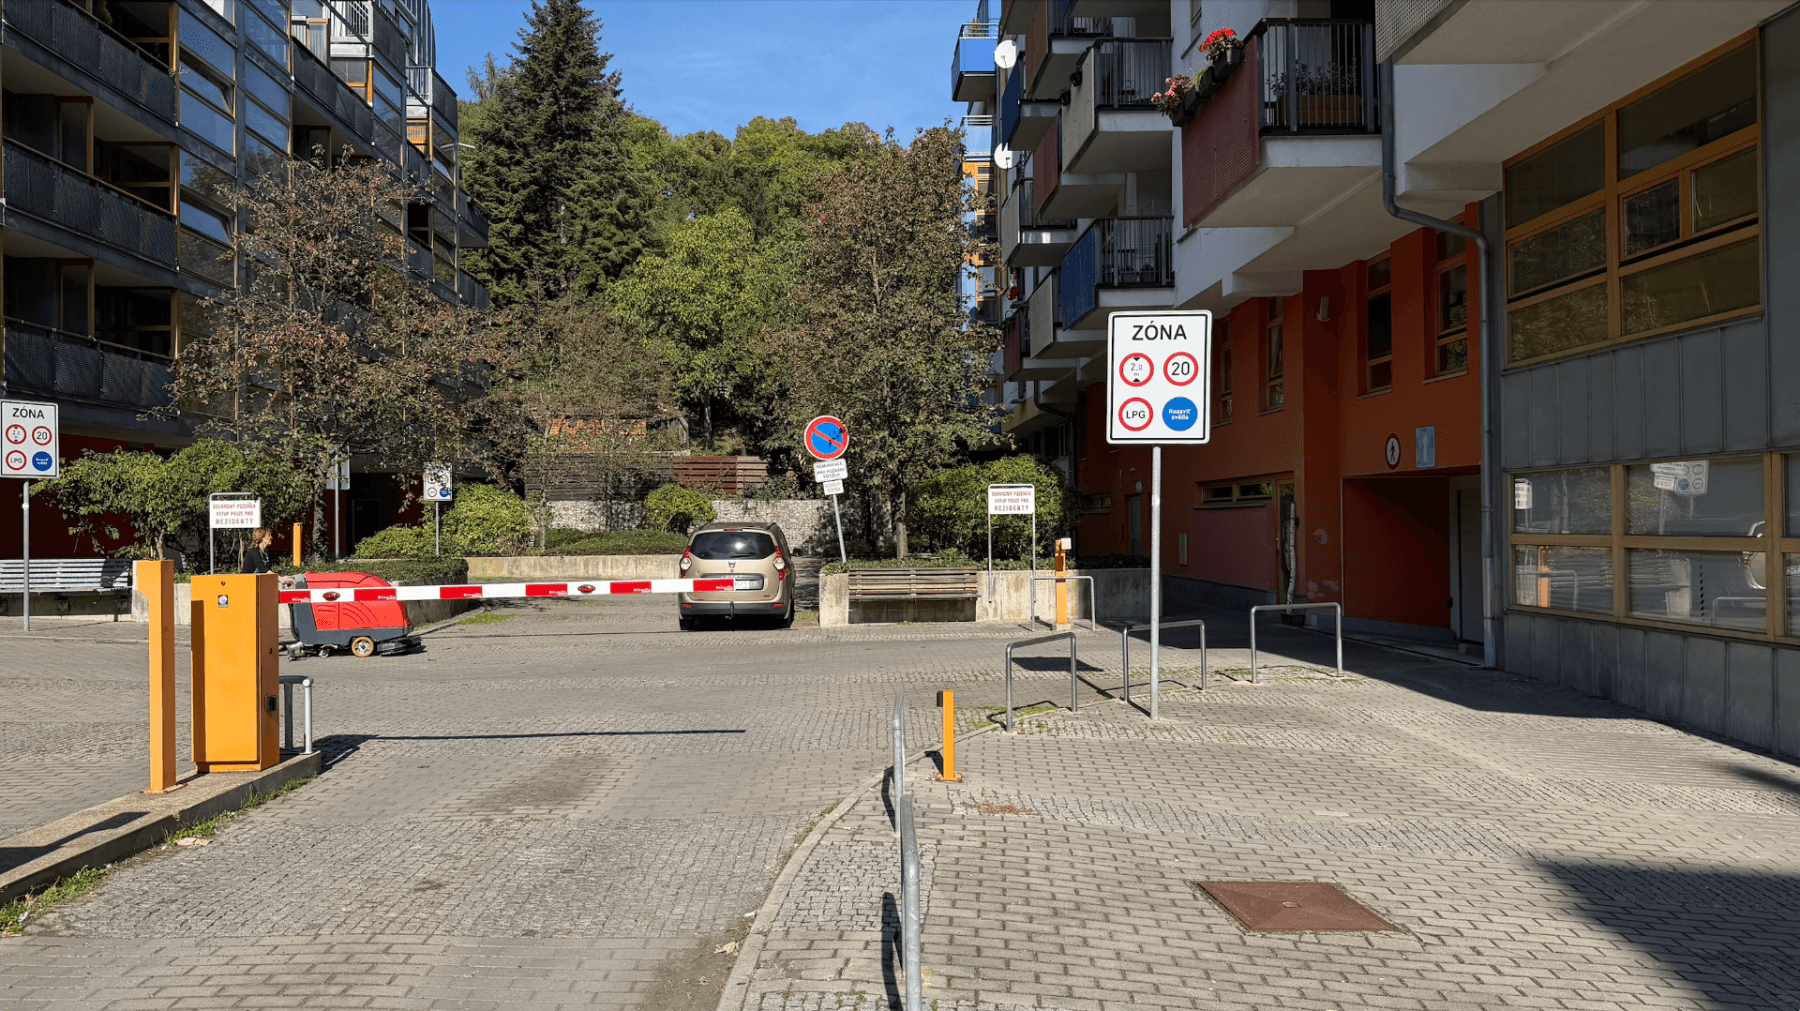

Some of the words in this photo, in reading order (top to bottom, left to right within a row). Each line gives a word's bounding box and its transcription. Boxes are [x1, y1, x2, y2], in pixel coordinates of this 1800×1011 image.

[1132, 320, 1187, 341] ZÓNA
[1171, 361, 1190, 376] 20
[13, 406, 44, 419] ZÓNA
[1126, 410, 1146, 419] LPG
[37, 431, 47, 440] 20
